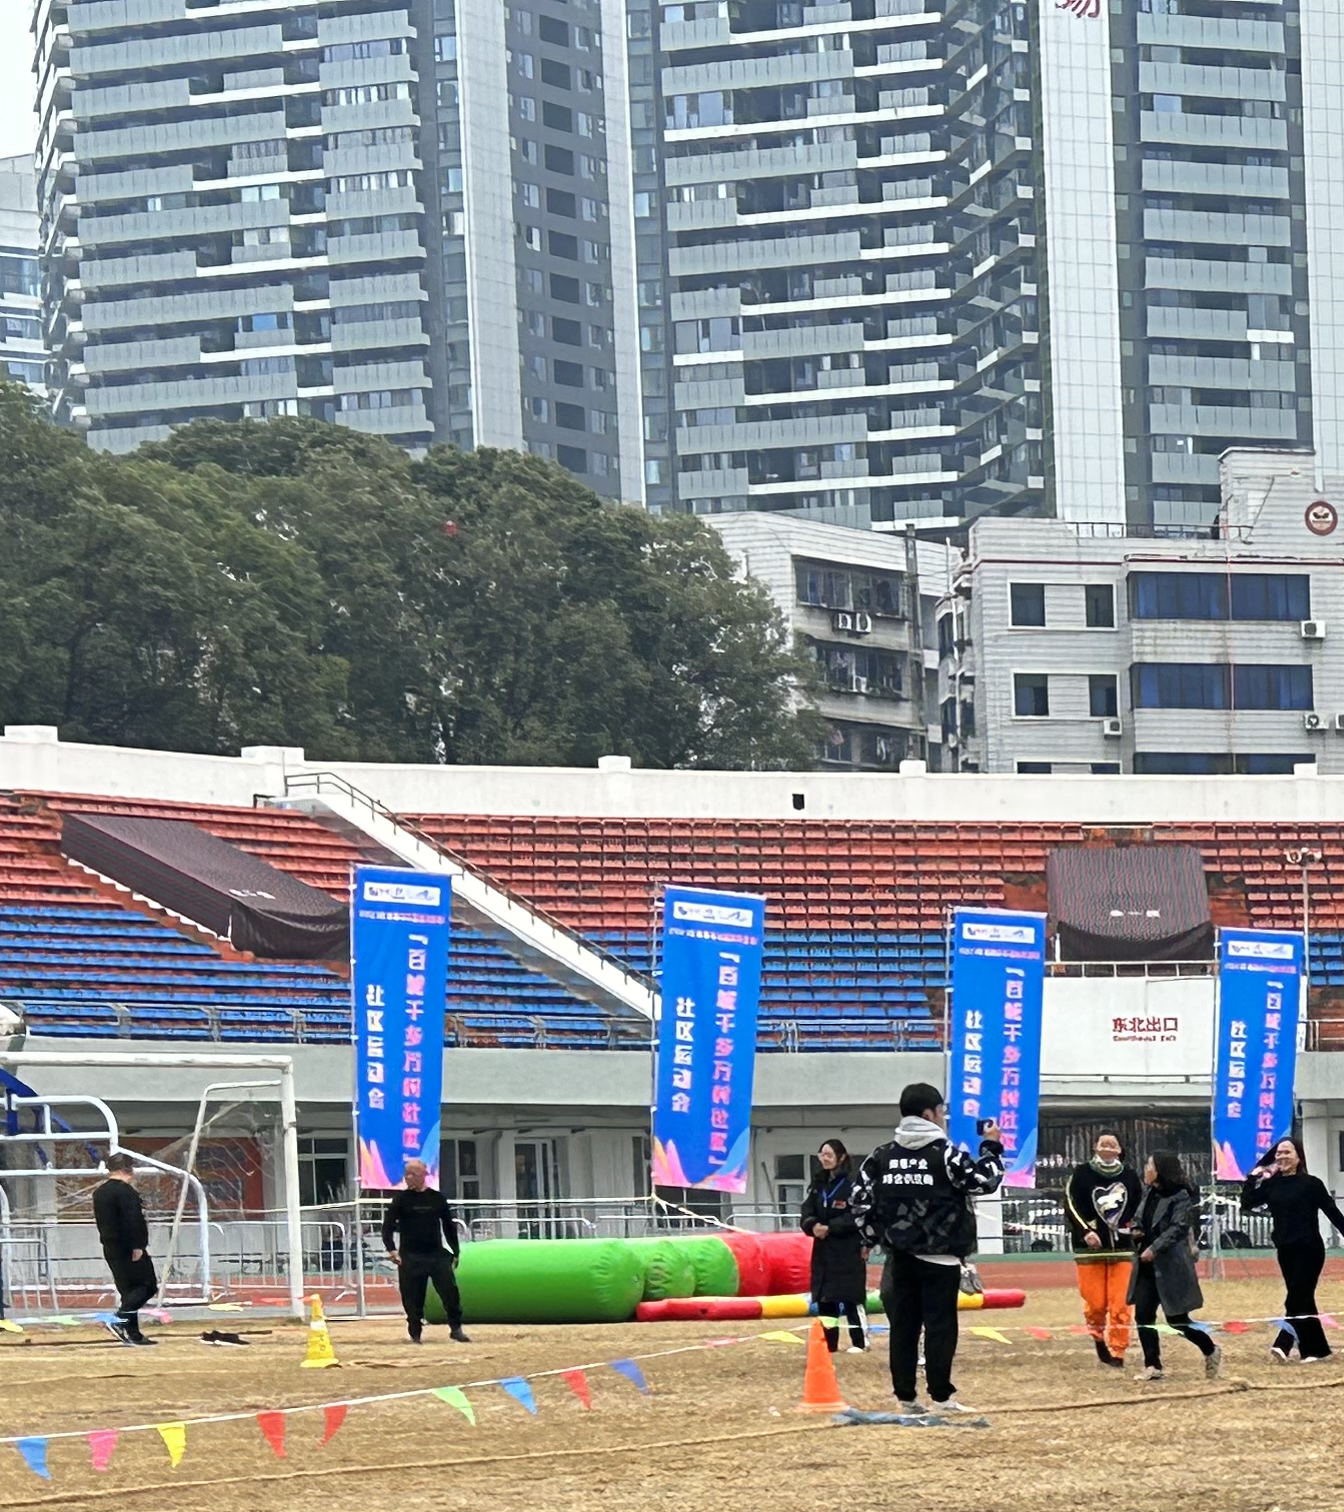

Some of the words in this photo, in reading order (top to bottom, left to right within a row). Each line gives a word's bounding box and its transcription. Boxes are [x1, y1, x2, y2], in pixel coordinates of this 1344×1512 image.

[365, 984, 387, 1111] 社区运动会
[671, 996, 697, 1114] 社区运动会
[1112, 1016, 1178, 1033] 东北出口
